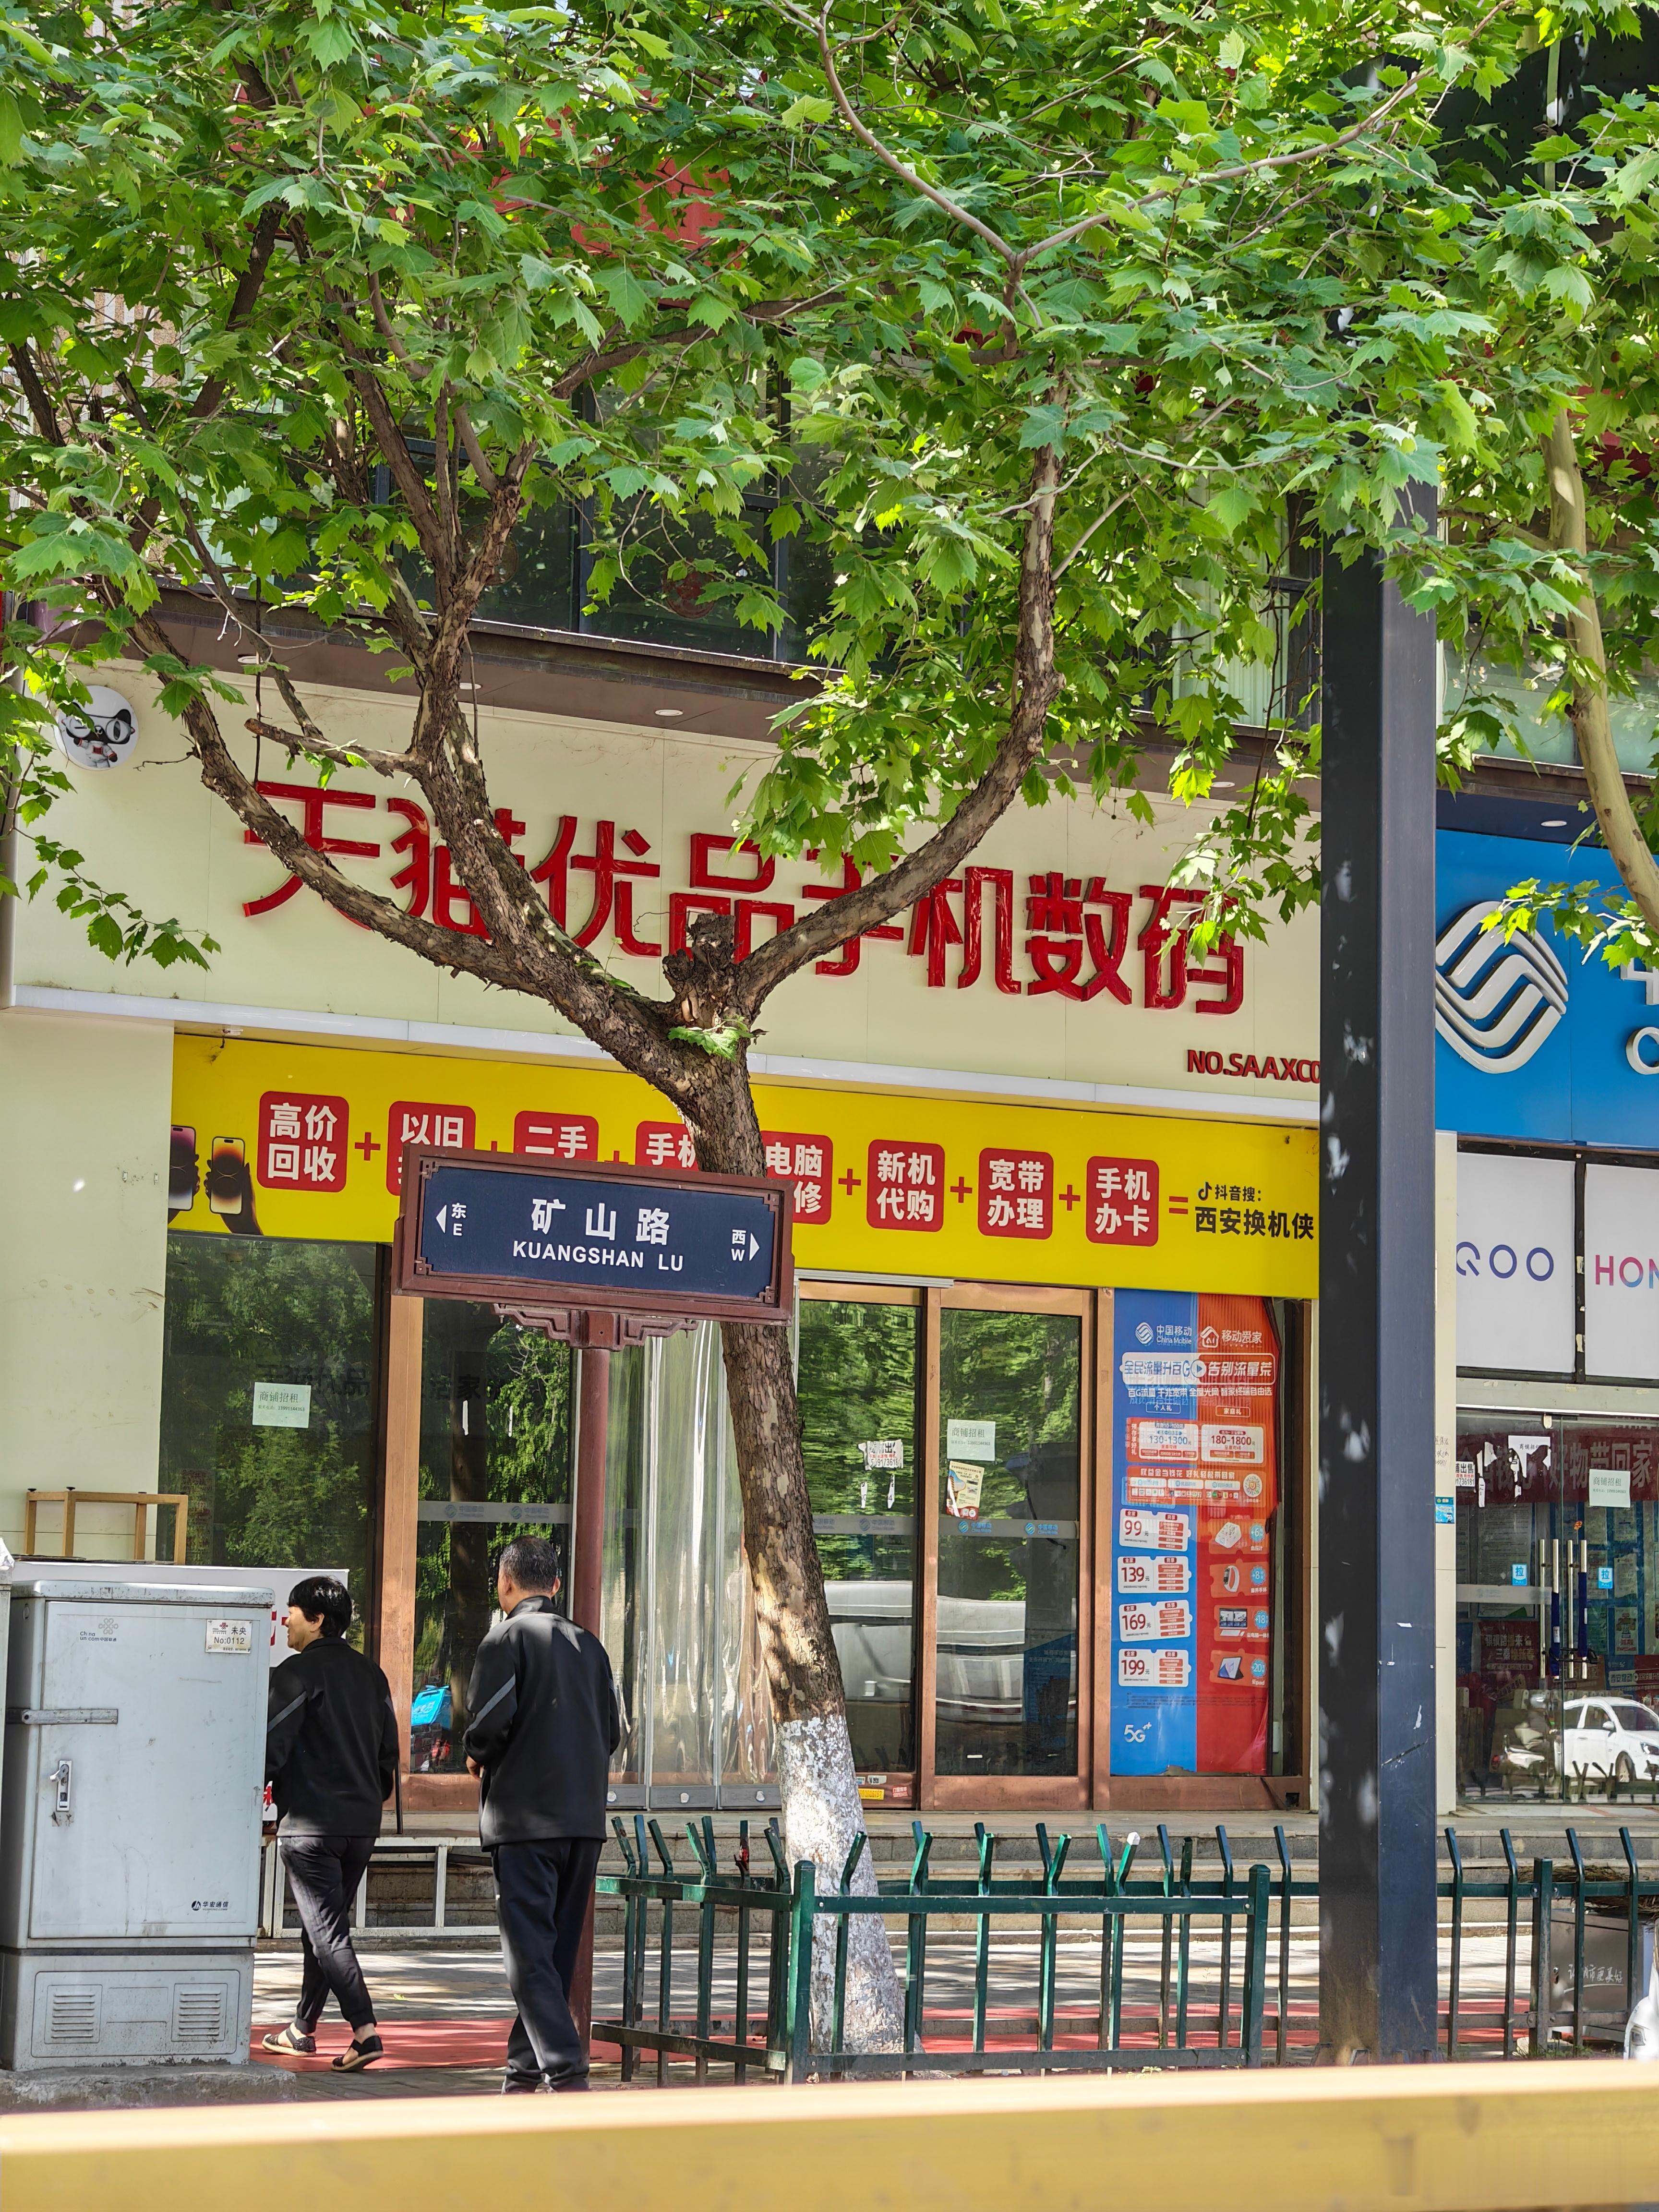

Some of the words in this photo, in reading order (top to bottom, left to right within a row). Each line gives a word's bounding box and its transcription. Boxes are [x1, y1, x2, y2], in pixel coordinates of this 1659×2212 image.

[269, 1103, 337, 1142] 高价
[400, 1113, 464, 1148] 以旧
[525, 1125, 588, 1158] 二手
[267, 1143, 337, 1182] 回收
[765, 1142, 822, 1178] 电脑
[877, 1150, 935, 1186] 新机
[988, 1159, 1045, 1192] 宽带
[1095, 1167, 1151, 1201] 手机
[451, 1203, 467, 1219] 东
[877, 1188, 934, 1222] 代购
[987, 1195, 1044, 1229] 办理
[531, 1198, 670, 1246] 矿山路
[1094, 1203, 1150, 1237] 办卡
[1195, 1206, 1314, 1240] 西安换机侠
[453, 1224, 462, 1237] E
[732, 1229, 746, 1245] 西
[513, 1240, 644, 1268] KUANGSHAN
[658, 1253, 684, 1272] LU
[731, 1249, 745, 1262] W
[1156, 1324, 1192, 1336] 中国移动
[1221, 1329, 1262, 1344] 移动爱家
[1124, 1360, 1190, 1377] 全民流量升百G
[1208, 1361, 1272, 1376] 告别流量荒
[259, 1391, 299, 1403] 商铺招租
[1128, 1388, 1156, 1397] 百G流量
[1157, 1387, 1188, 1397] 千兆宽带
[1189, 1387, 1219, 1397] 全屋光网
[1221, 1387, 1273, 1396] 智家终端自由选
[952, 1428, 985, 1438] 商铺招租
[1593, 1477, 1621, 1487] 商铺招租
[1515, 1566, 1524, 1576] 拉
[1601, 1569, 1610, 1579] 拉
[231, 1626, 247, 1635] 未央
[214, 1636, 245, 1645] No:0112
